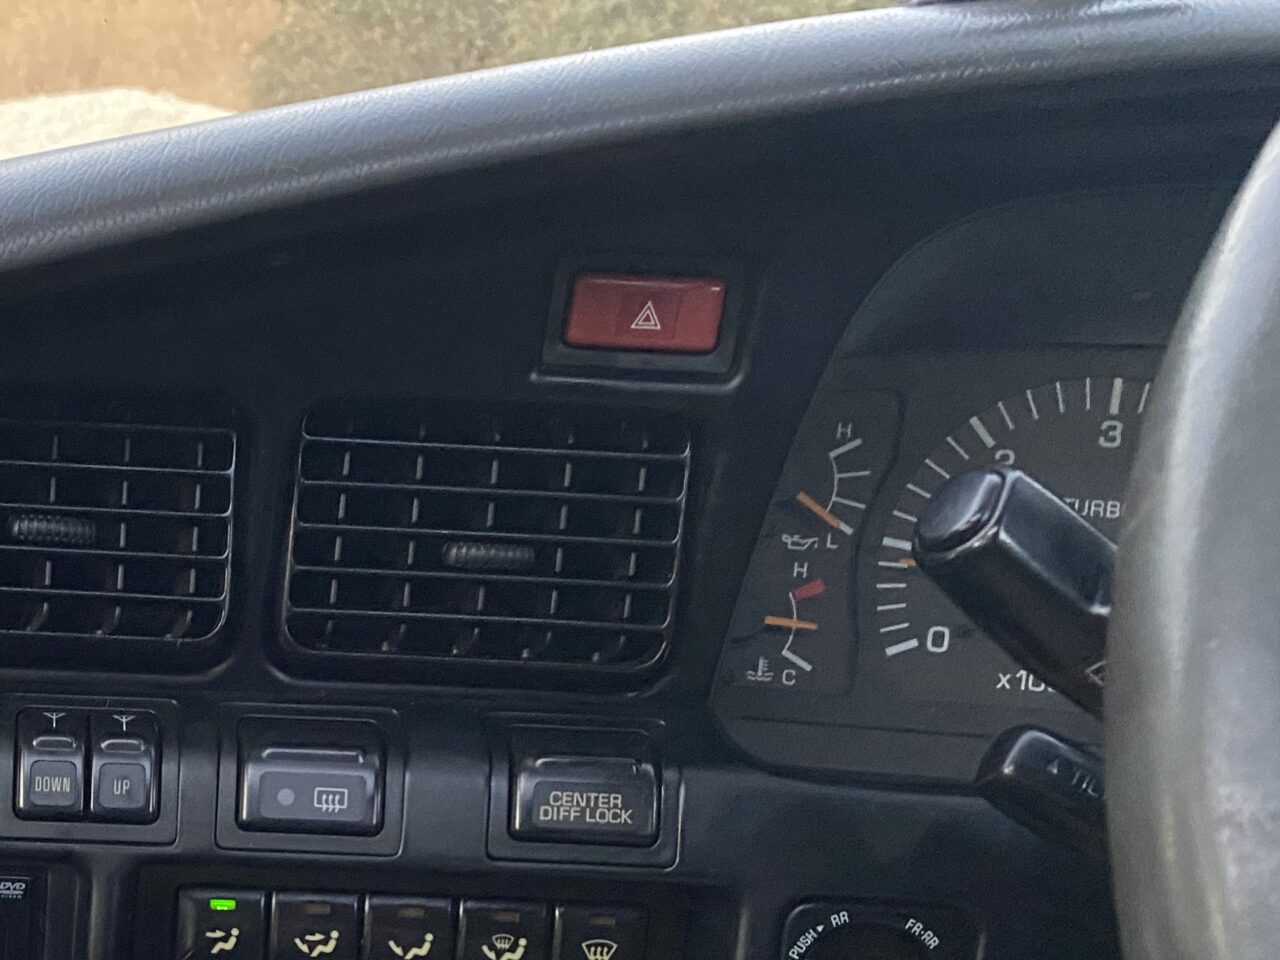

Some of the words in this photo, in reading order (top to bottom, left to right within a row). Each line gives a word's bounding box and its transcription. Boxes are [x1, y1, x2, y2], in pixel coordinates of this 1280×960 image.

[836, 423, 851, 438] H
[1098, 421, 1123, 448] 3
[1064, 498, 1121, 518] URB
[827, 533, 838, 548] L
[793, 562, 808, 578] H
[926, 626, 950, 653] 0
[782, 669, 796, 685] C
[35, 776, 71, 792] DOWN
[113, 779, 130, 795] UP
[549, 791, 622, 808] CENTER
[539, 805, 581, 821] DIFF
[586, 808, 633, 824] LOCK
[830, 911, 849, 927] RR
[788, 929, 818, 960] PUSH
